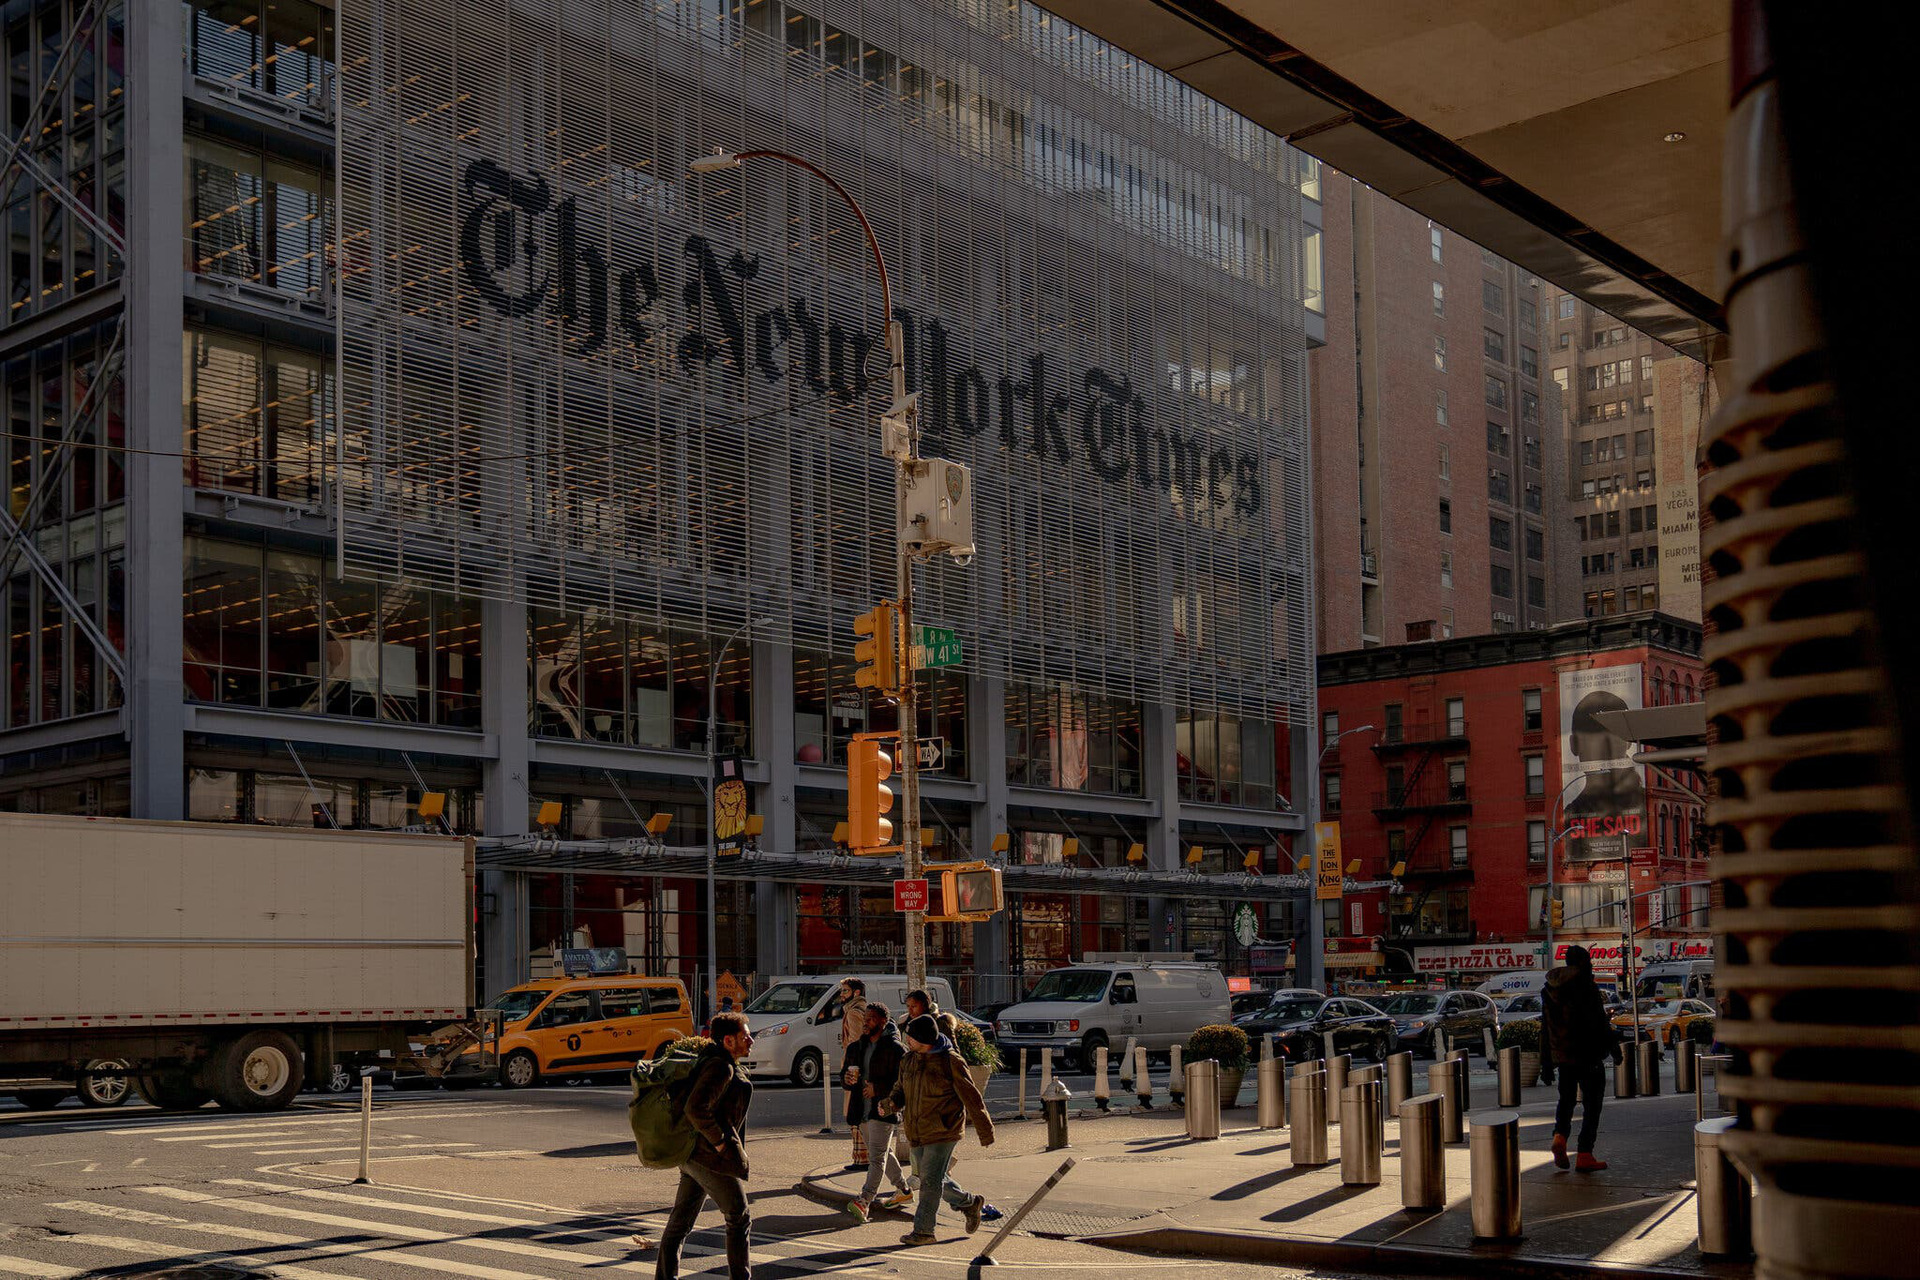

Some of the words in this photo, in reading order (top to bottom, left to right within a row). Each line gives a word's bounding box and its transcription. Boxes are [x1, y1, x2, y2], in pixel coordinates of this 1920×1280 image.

[461, 158, 661, 357] The
[677, 233, 868, 401] New
[892, 306, 1071, 464] York
[1082, 365, 1262, 518] Times
[1666, 498, 1694, 510] VEGAS
[1662, 523, 1693, 536] MIAMI
[1665, 545, 1698, 558] EUROPE
[930, 630, 936, 645] 8
[926, 647, 935, 665] W
[938, 645, 949, 663] 41
[952, 643, 960, 655] St
[920, 747, 936, 760] WAY
[1570, 816, 1602, 839] SHE
[1603, 814, 1641, 837] SAID
[1322, 848, 1335, 857] THE
[1320, 860, 1338, 872] LION
[1319, 873, 1340, 887] KING
[900, 891, 922, 900] WRONG
[904, 899, 918, 908] WAY
[841, 939, 863, 957] The
[861, 939, 887, 956] New
[886, 939, 906, 960] Yor
[1449, 955, 1494, 969] PIZZA
[1496, 954, 1535, 968] CAFE
[1502, 980, 1531, 989] SHOW
